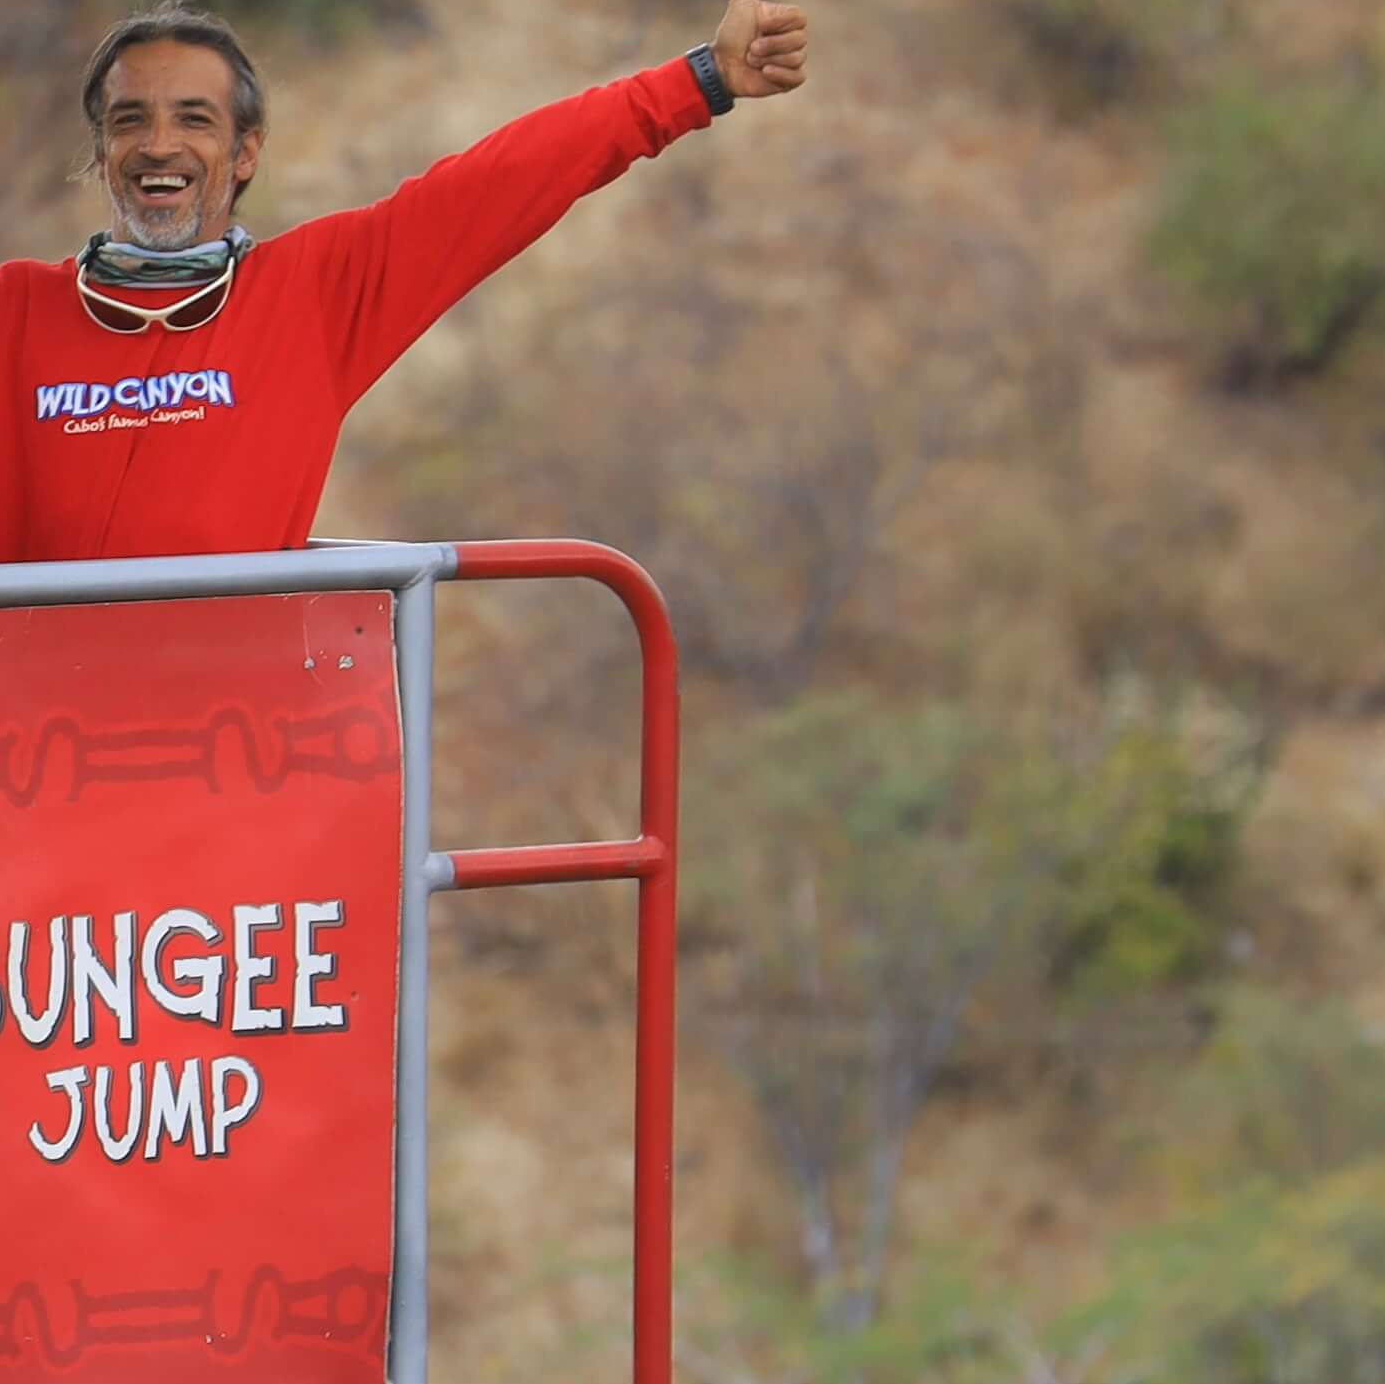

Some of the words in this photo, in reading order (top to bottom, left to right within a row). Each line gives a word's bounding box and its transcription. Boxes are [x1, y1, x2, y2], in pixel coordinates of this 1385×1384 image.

[35, 381, 112, 421] WILD
[63, 416, 106, 434] Cabo's
[107, 413, 149, 429] famus
[27, 1054, 263, 1165] JUMP
